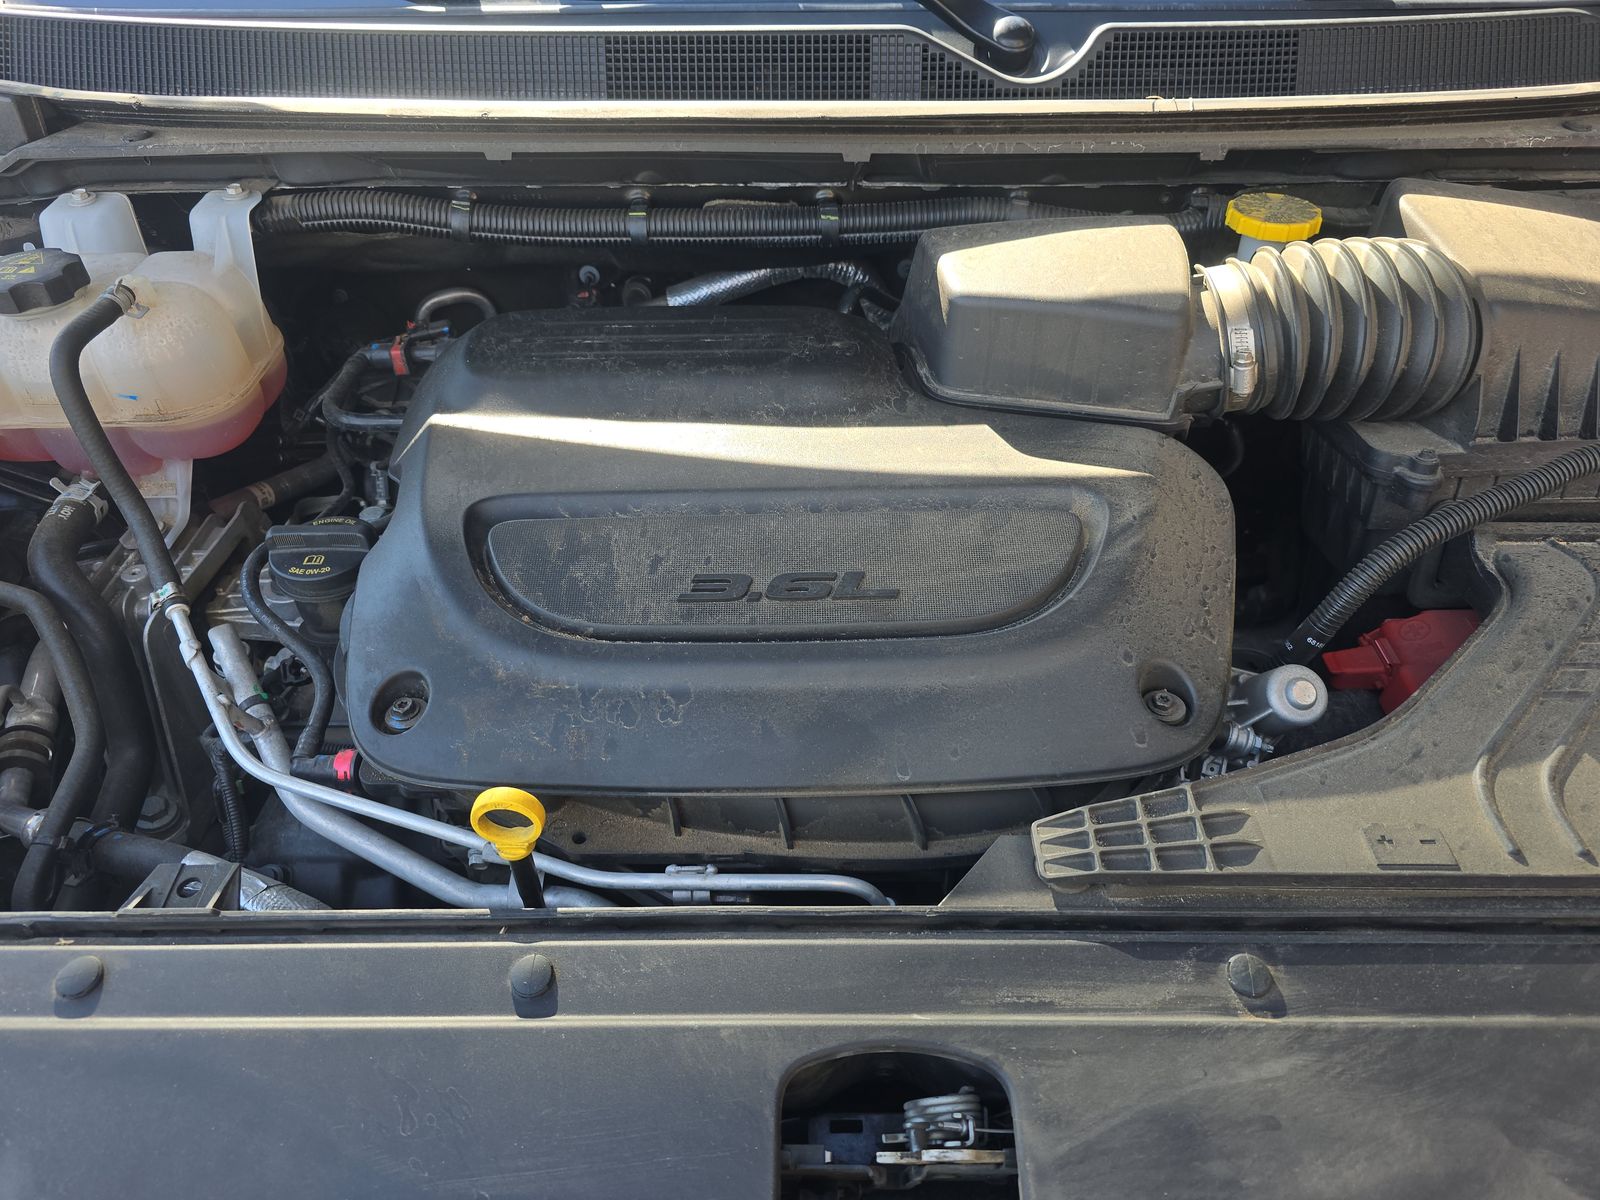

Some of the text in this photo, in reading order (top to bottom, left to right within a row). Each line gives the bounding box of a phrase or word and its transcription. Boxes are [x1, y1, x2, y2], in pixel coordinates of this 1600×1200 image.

[312, 518, 344, 526] ENGINE
[288, 566, 305, 575] SAE
[677, 571, 899, 602] 3.6L
